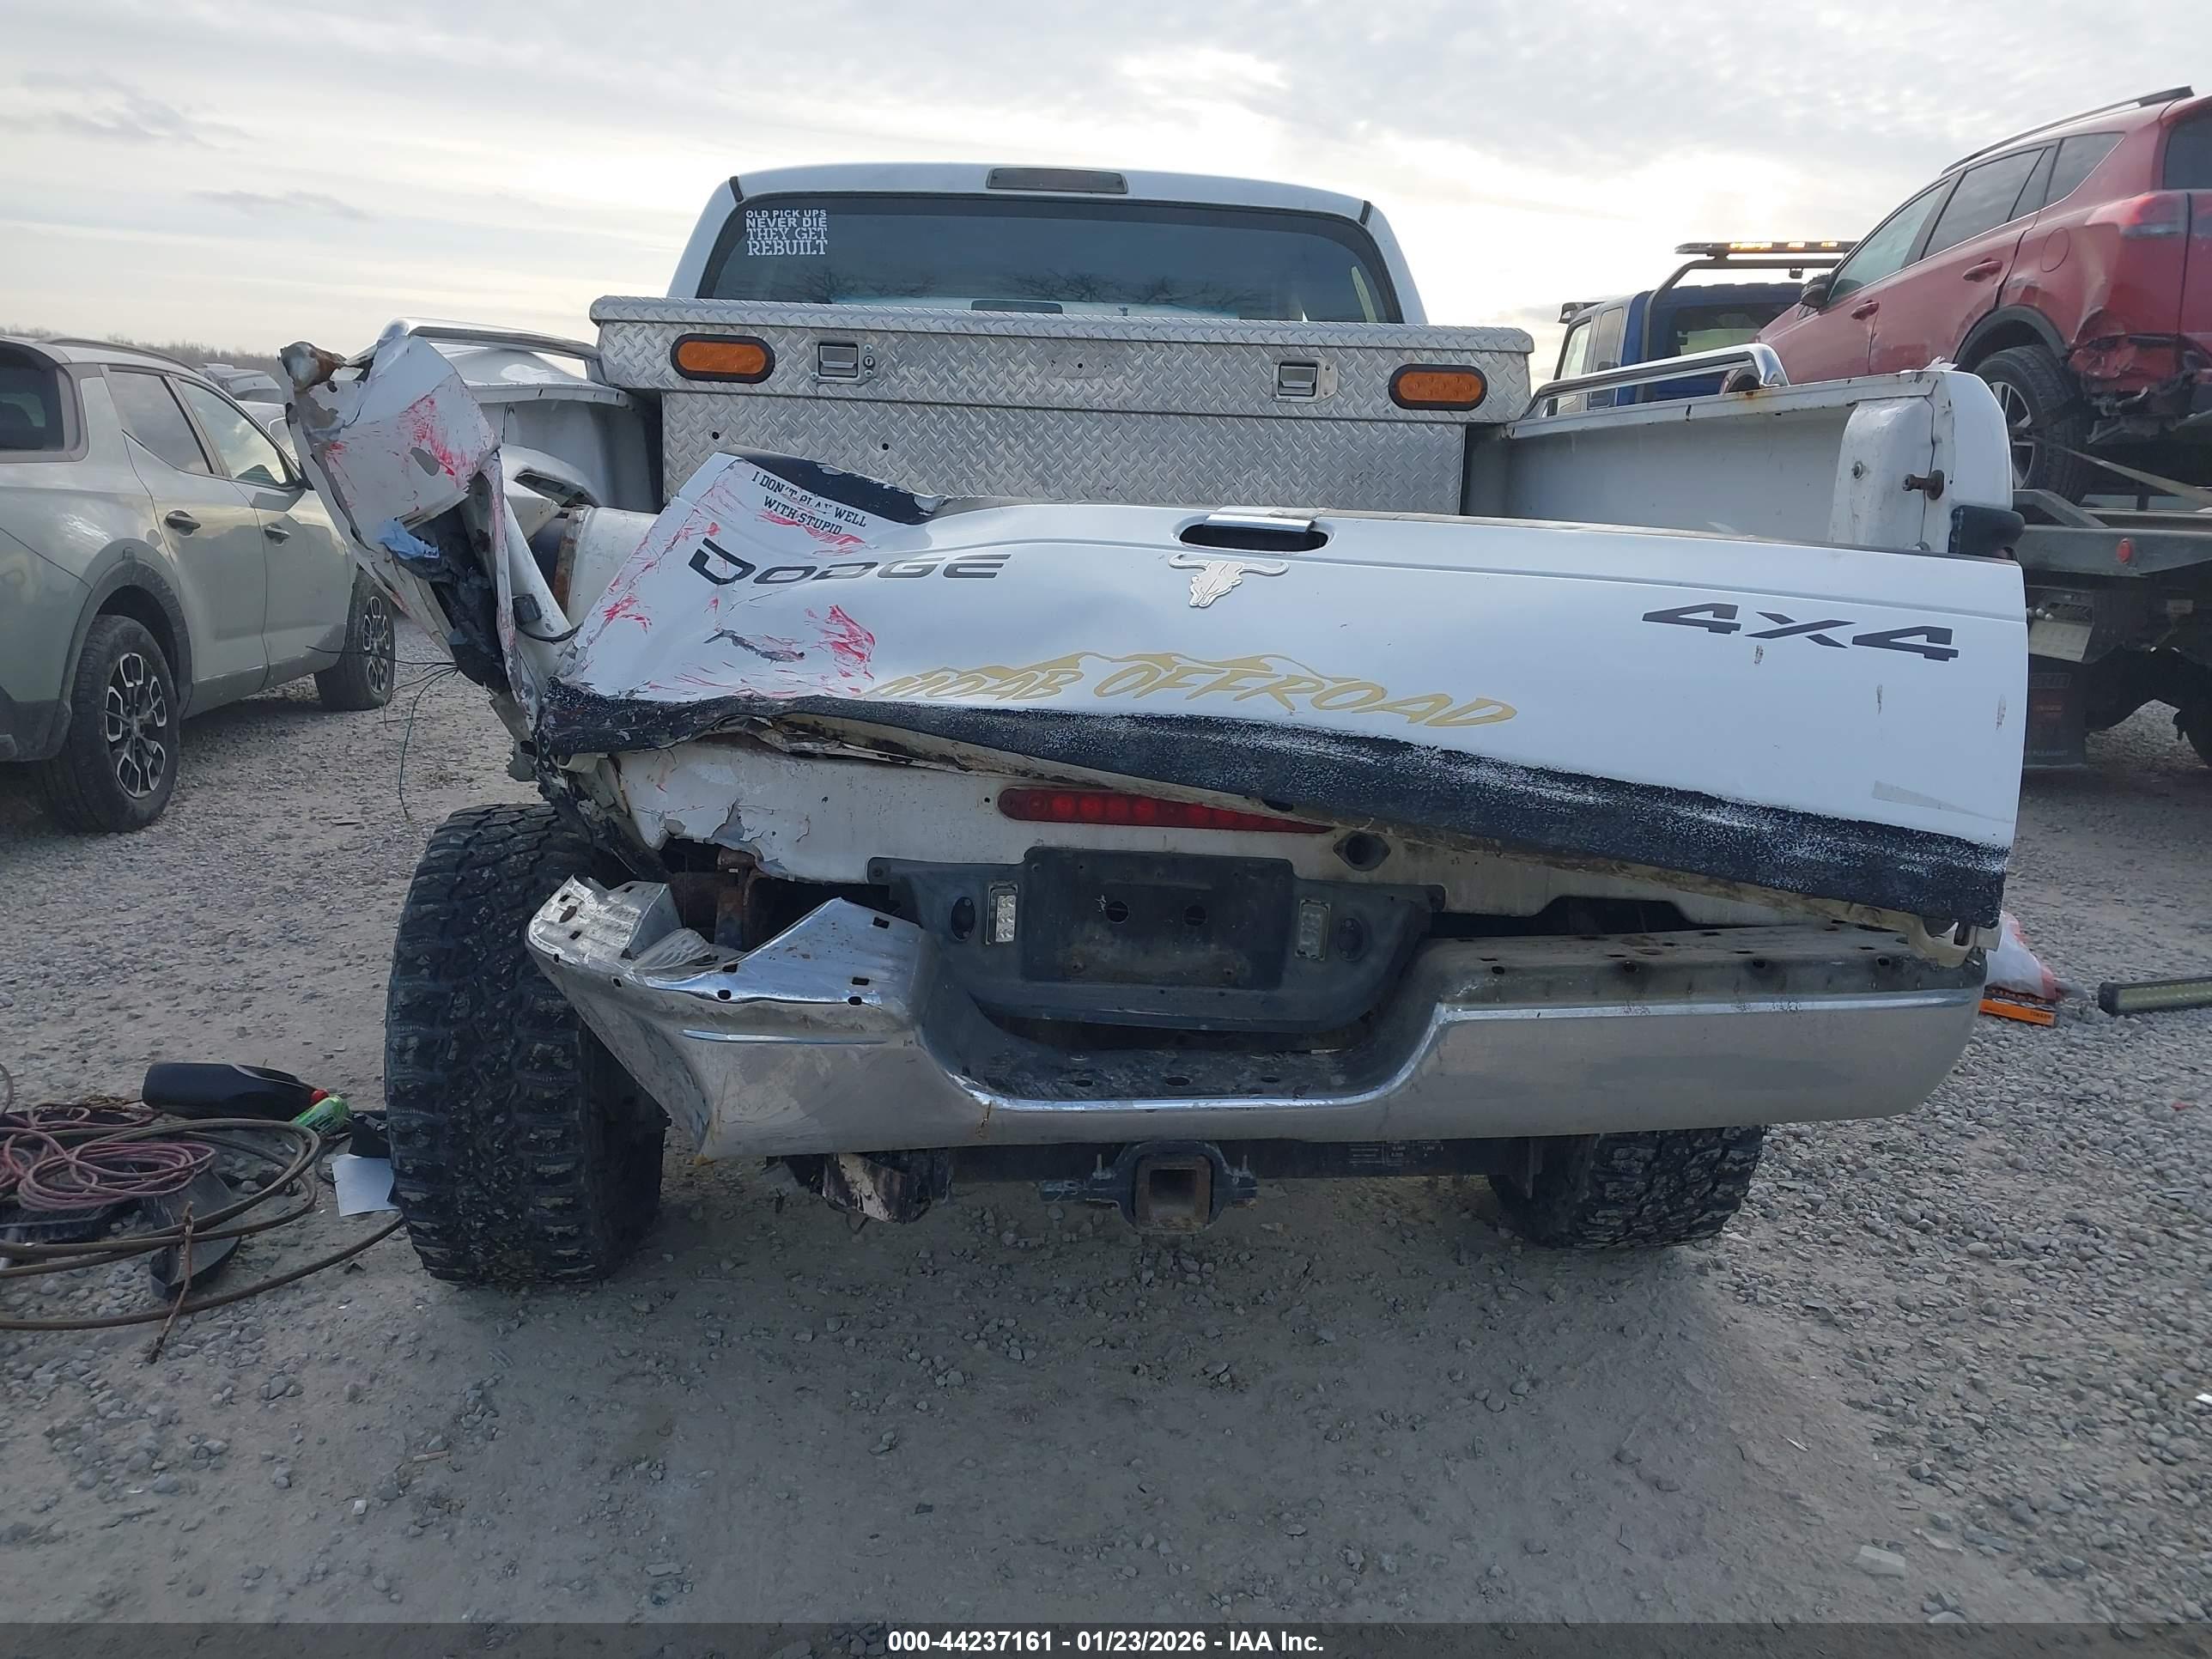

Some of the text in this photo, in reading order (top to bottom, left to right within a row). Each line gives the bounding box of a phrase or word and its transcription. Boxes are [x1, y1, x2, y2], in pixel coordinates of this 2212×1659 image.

[745, 217, 828, 228] NEVER DIE
[746, 227, 828, 240] THEY GET
[746, 240, 829, 256] REBUILT
[751, 471, 760, 483] I
[758, 474, 798, 498] DON'T
[834, 506, 867, 528] WELL
[763, 495, 843, 535] WITH STUPID
[688, 537, 1012, 586] DODGE
[1641, 603, 1960, 662] 4X4
[1092, 661, 1518, 727] OFFROAD
